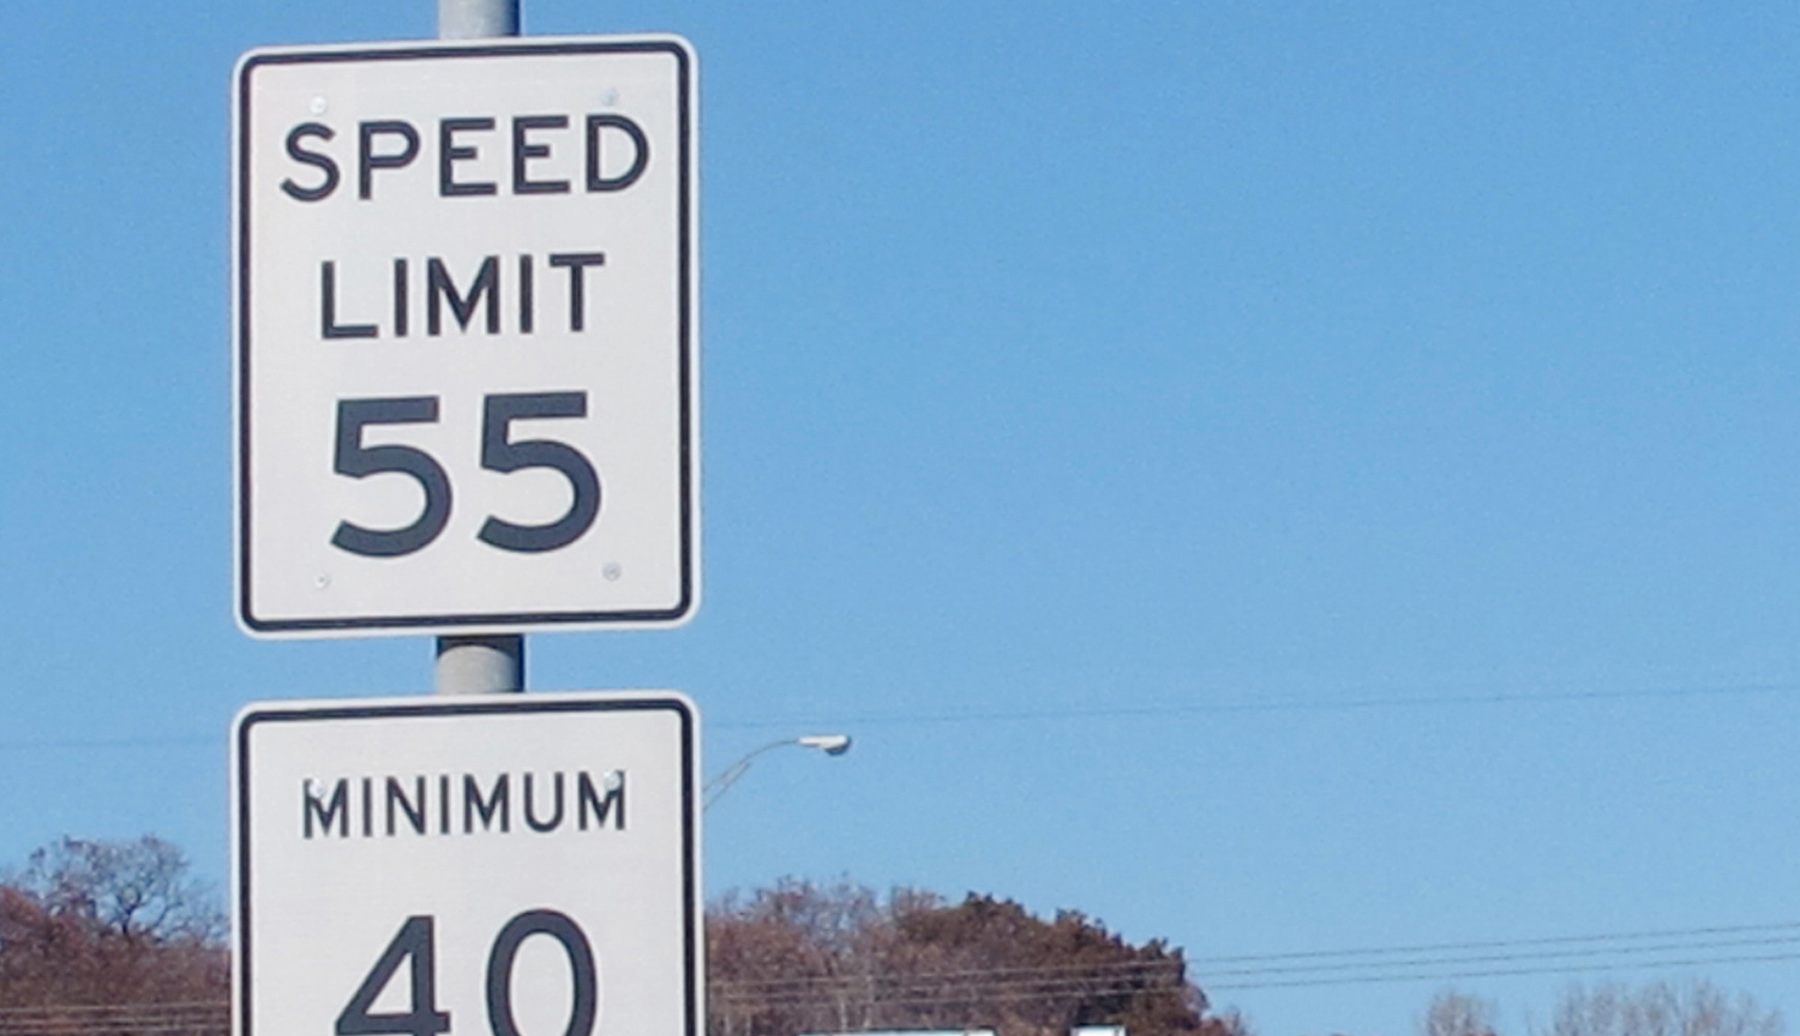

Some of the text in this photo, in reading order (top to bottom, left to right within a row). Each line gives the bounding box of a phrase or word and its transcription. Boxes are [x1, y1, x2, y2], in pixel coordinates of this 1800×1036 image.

[280, 114, 650, 202] SPEED
[321, 253, 605, 339] LIMIT
[331, 391, 602, 558] 55
[303, 771, 627, 839] MINIMUM
